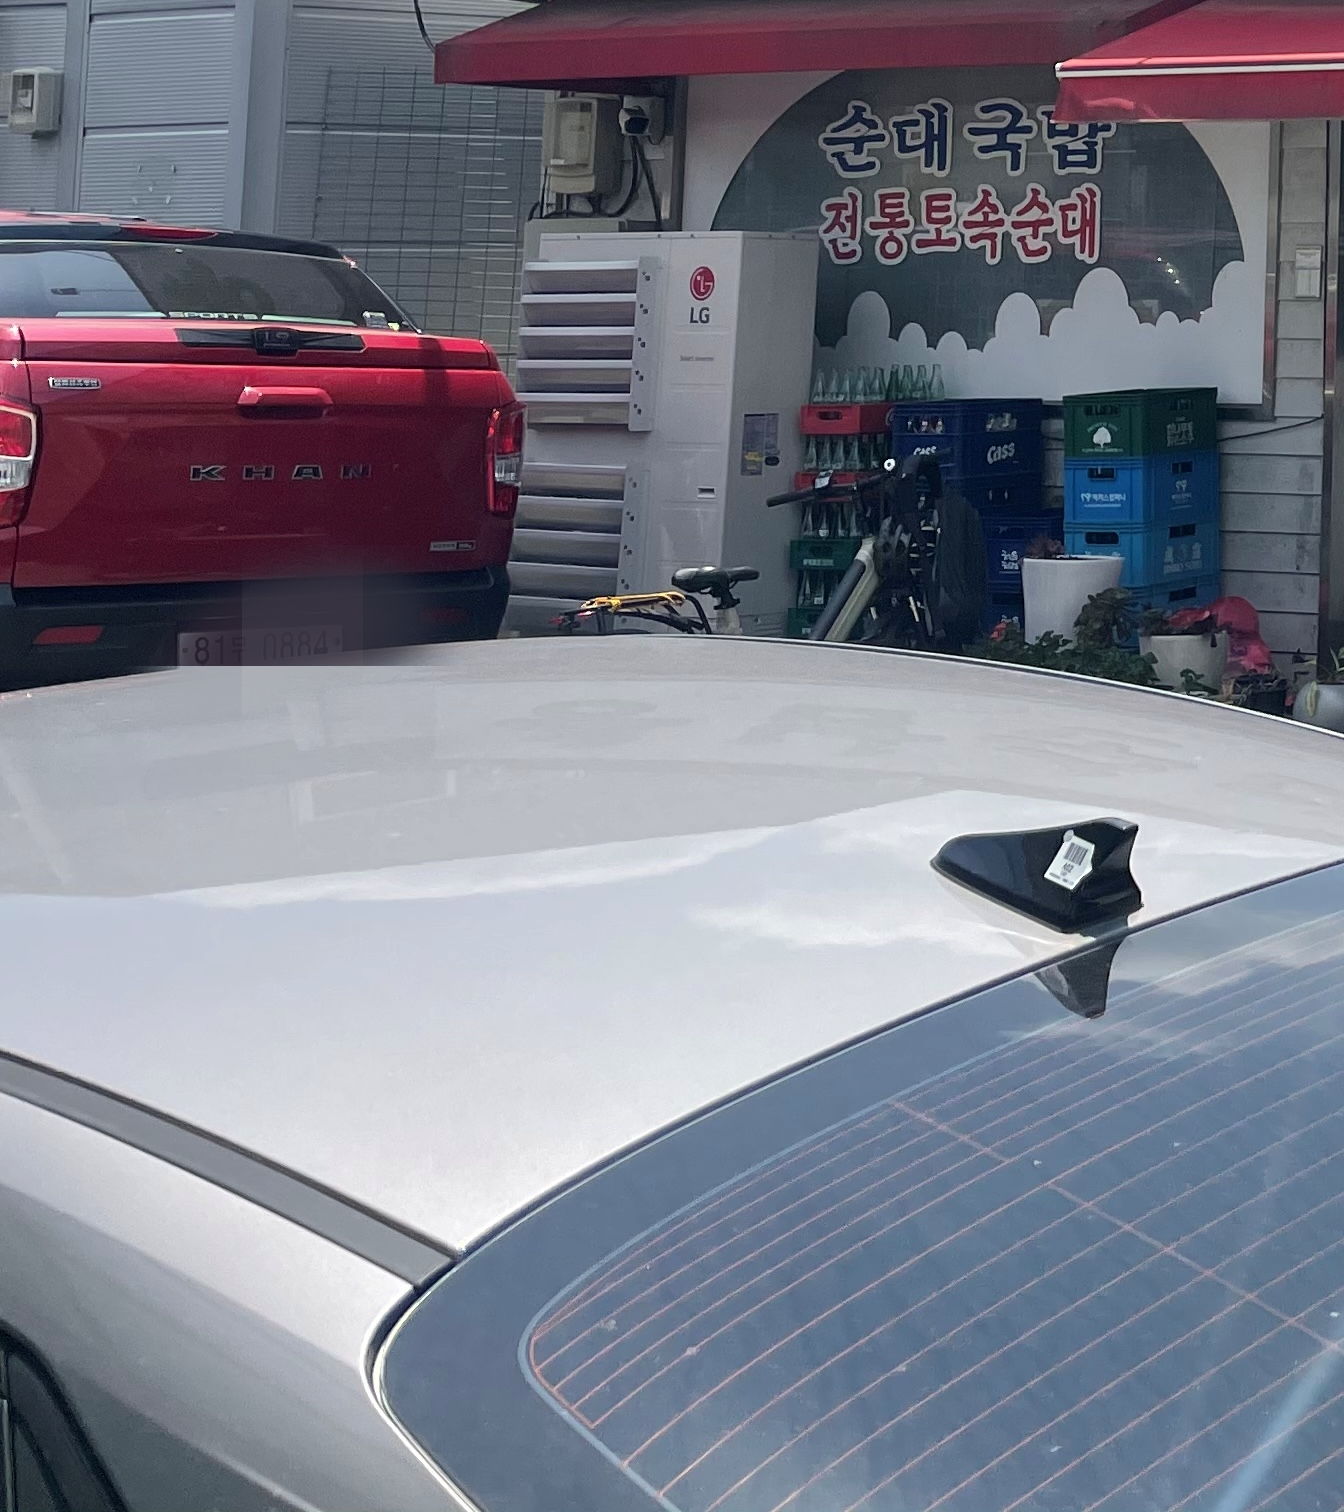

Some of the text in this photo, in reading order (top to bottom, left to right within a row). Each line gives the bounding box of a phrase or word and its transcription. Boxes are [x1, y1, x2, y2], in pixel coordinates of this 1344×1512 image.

[690, 307, 710, 324] LG
[986, 441, 1015, 464] Cass
[189, 464, 372, 482] KHAN
